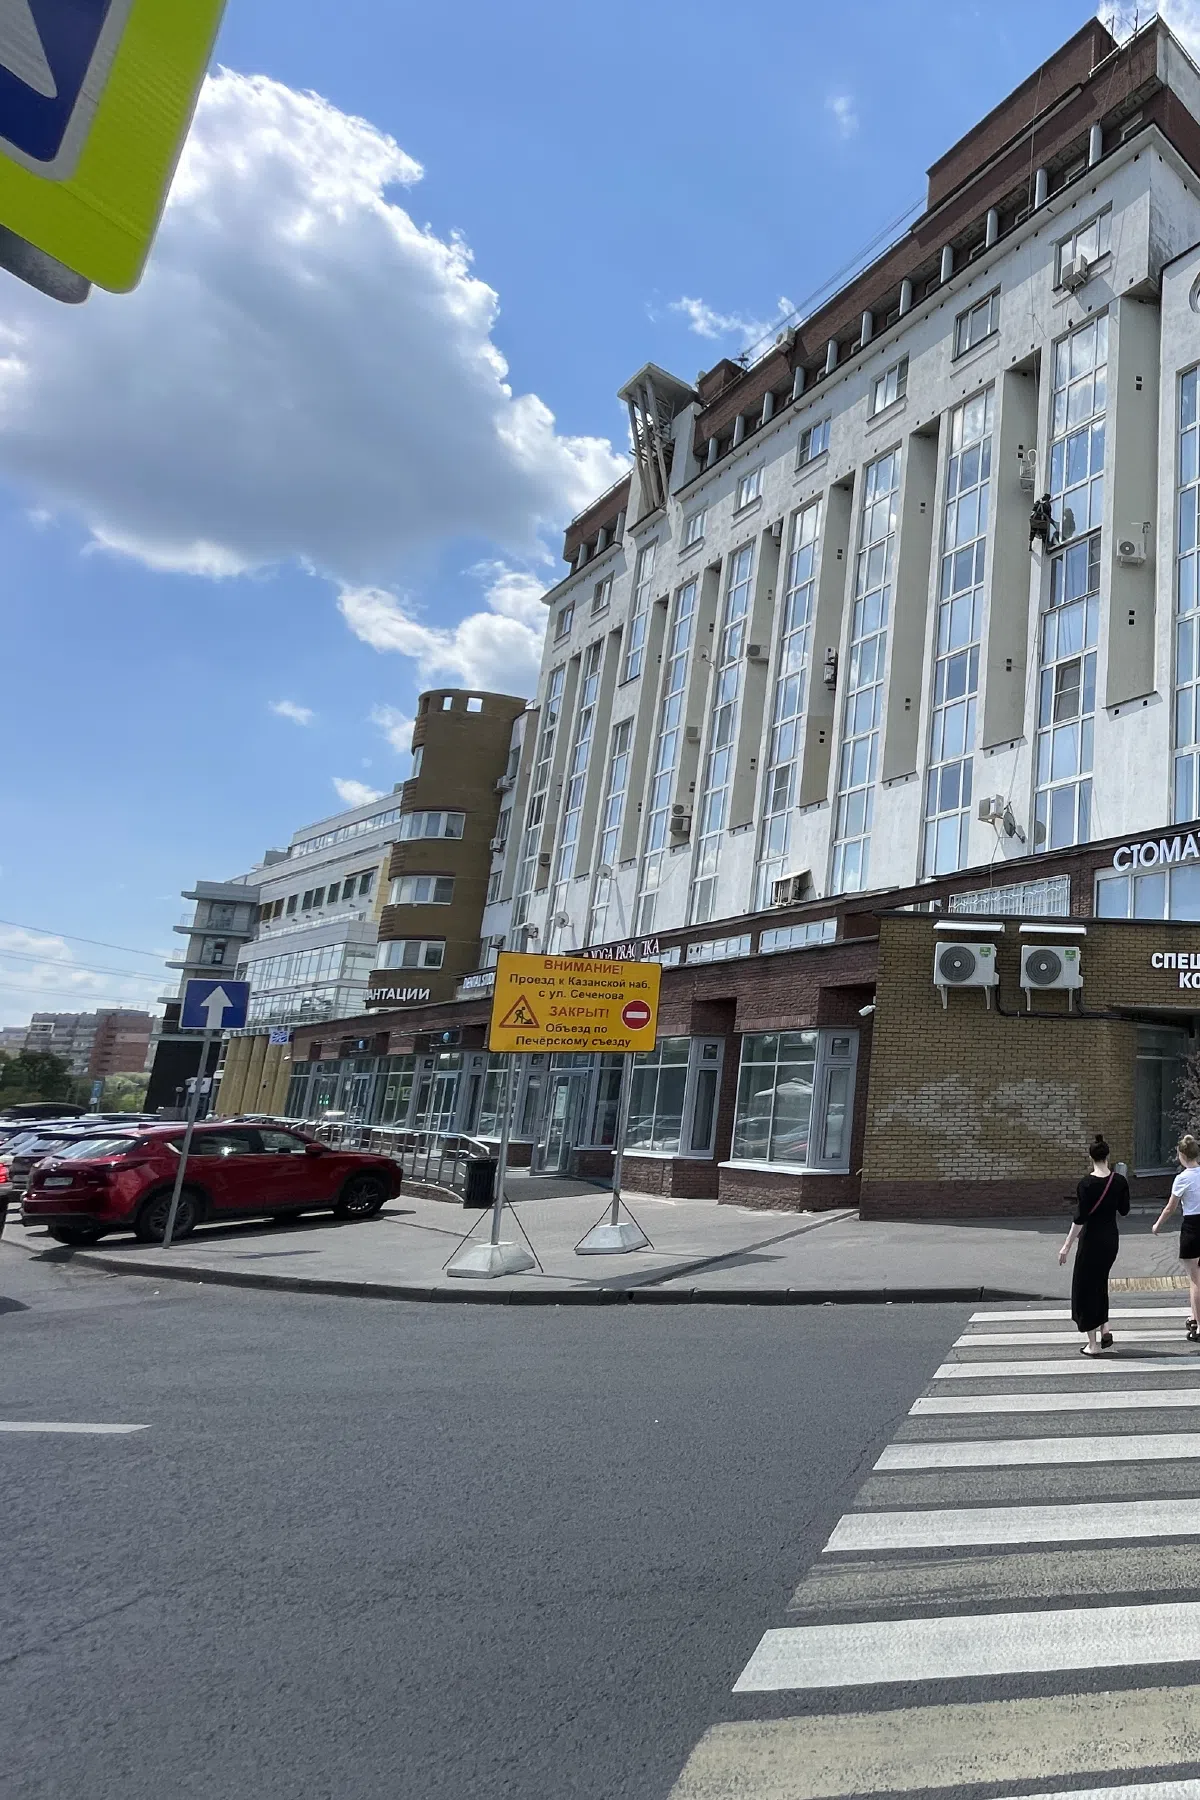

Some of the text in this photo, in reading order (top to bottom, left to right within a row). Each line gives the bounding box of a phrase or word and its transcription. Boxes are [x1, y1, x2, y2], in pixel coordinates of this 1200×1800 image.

[544, 959, 624, 975] ВНИМАНИЕ!
[509, 973, 651, 989] Проезд к Казанской наб.
[538, 989, 624, 1000] с ул. Сеченова
[549, 1005, 609, 1019] ЗАКРЫТ!
[546, 1023, 608, 1035] Объезд по
[516, 1035, 632, 1048] Печёрскому съезду
